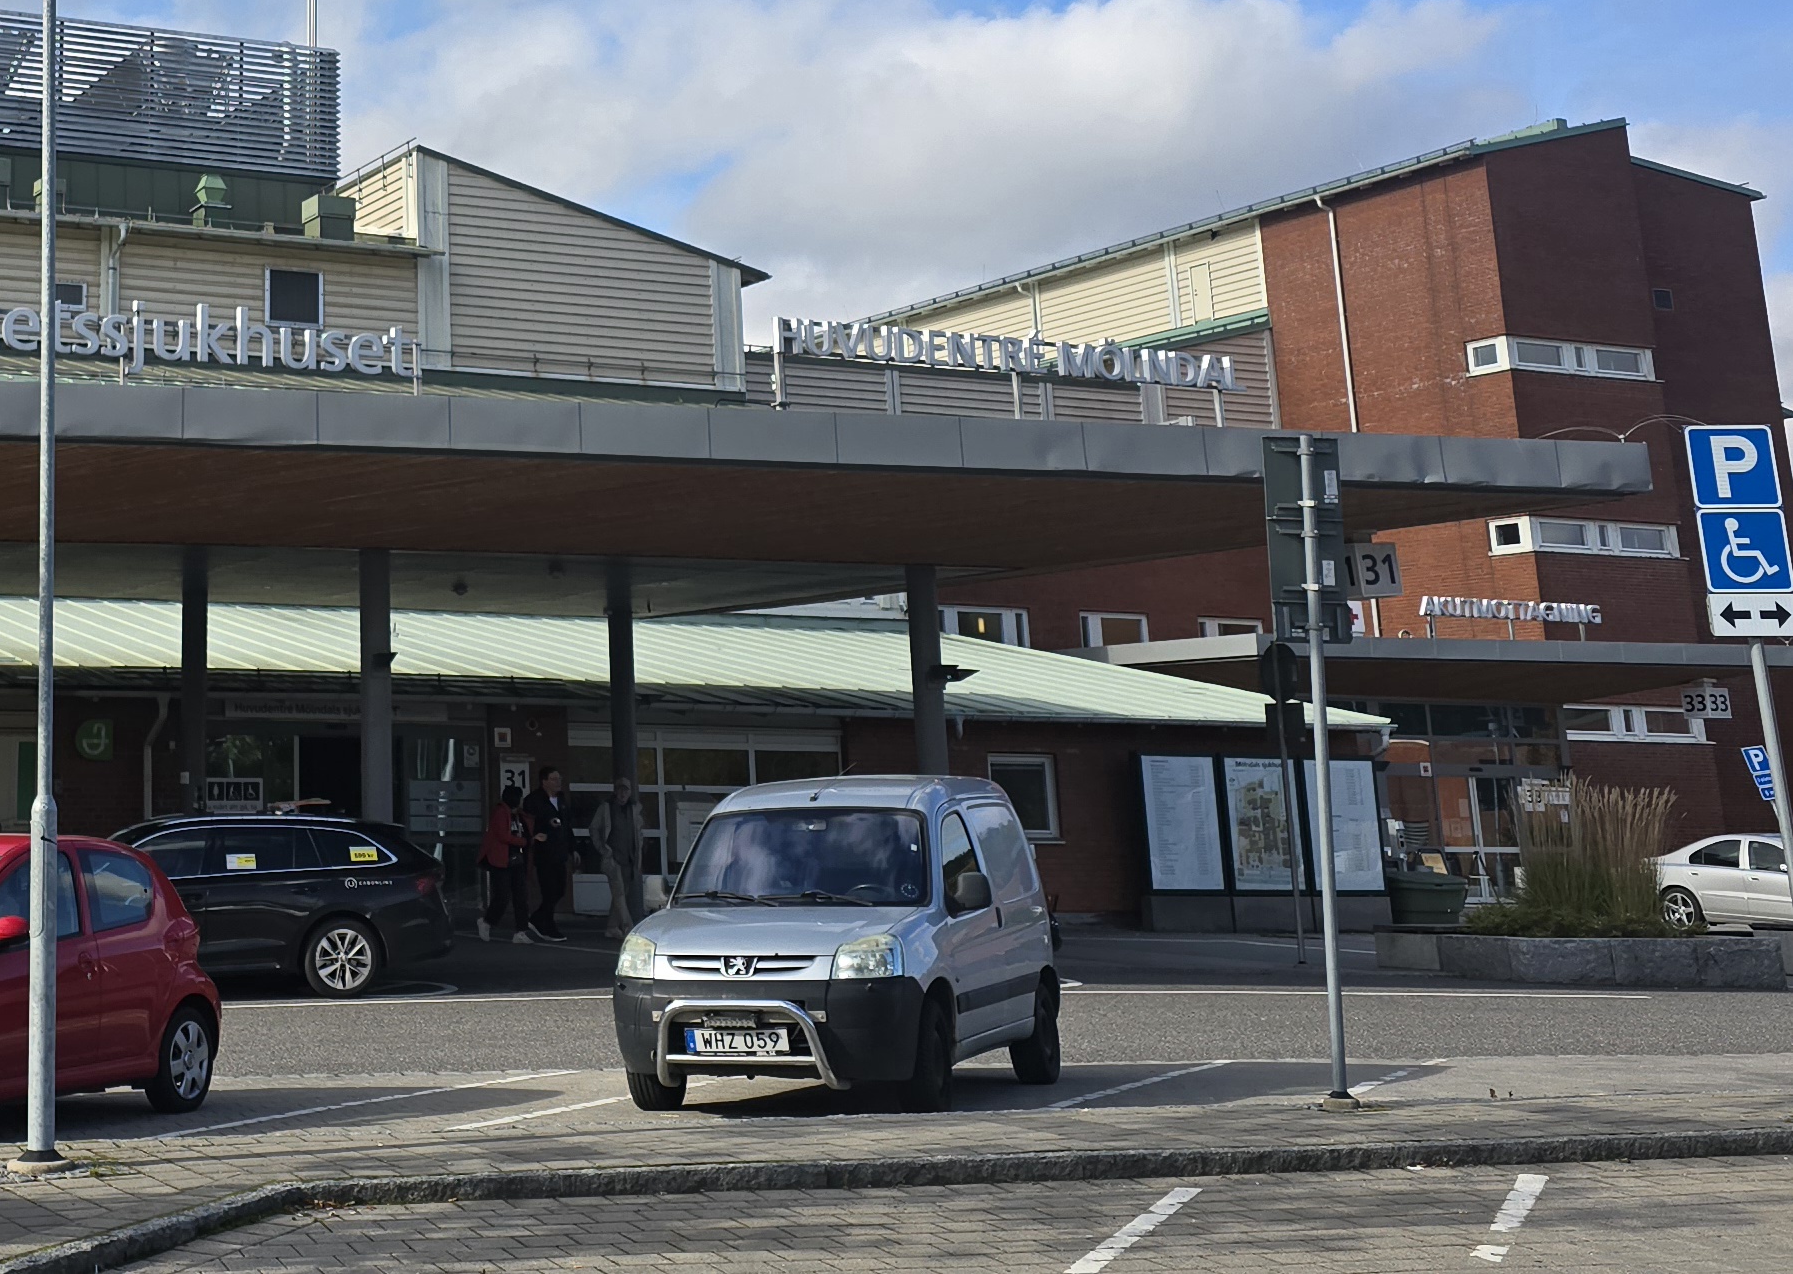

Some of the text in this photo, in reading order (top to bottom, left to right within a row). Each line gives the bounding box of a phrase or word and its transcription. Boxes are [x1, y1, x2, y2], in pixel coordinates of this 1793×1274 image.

[772, 316, 1248, 392] HUVUDENTRÉ MÖLNDAL
[1709, 435, 1758, 498] P
[1361, 553, 1397, 586] 31
[1418, 595, 1603, 624] AKUTMOTTAGNING
[1683, 693, 1707, 713] 33
[1709, 693, 1729, 712] 33
[1262, 761, 1283, 769] sjukhu
[1748, 749, 1764, 771] P
[701, 1031, 780, 1050] WHZ 059
